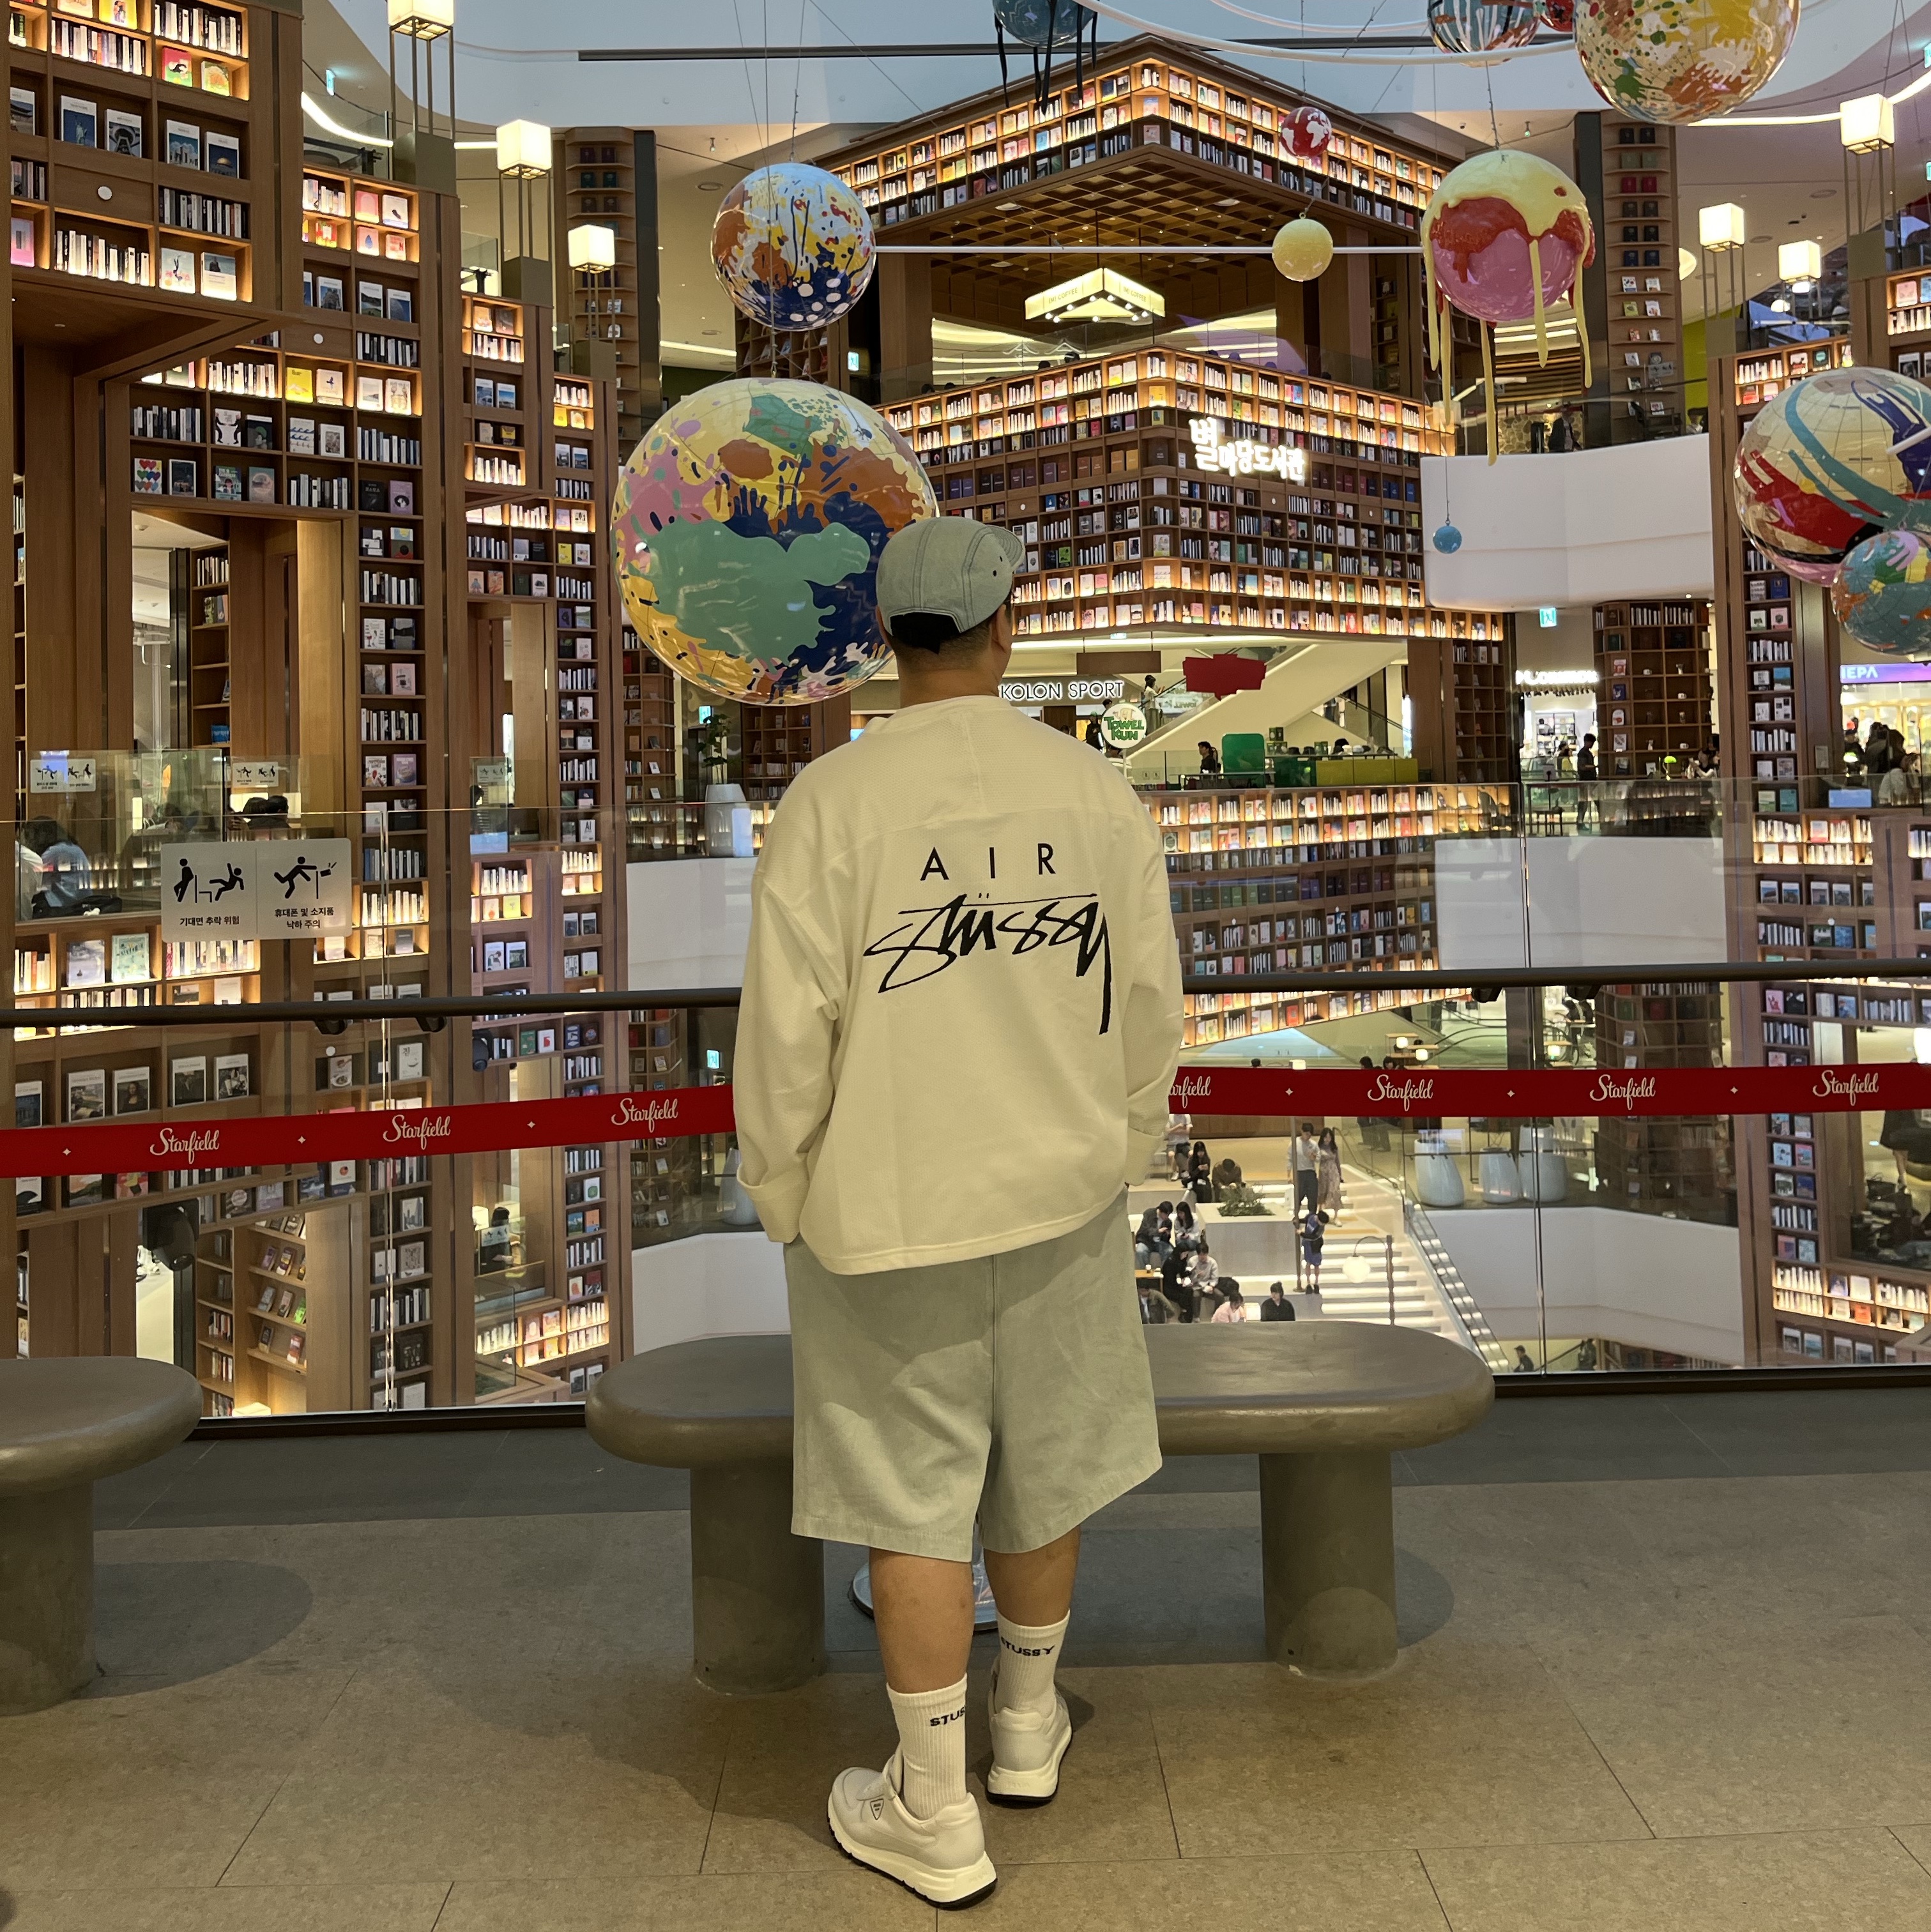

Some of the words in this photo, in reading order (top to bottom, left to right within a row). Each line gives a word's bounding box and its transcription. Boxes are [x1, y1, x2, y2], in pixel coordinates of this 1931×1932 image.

[999, 683, 1061, 701] KOLON
[1069, 681, 1124, 699] SPORT
[1104, 716, 1145, 730] TOWEL
[1111, 729, 1138, 741] KUN
[920, 843, 1056, 881] AIR
[179, 917, 204, 926] 기대면
[206, 917, 222, 925] 추락
[224, 916, 240, 925] 위험
[275, 908, 298, 917] 휴대폰
[300, 908, 309, 917] 및
[310, 907, 334, 916] 소지품
[287, 920, 303, 929] 낙하
[305, 920, 321, 929] 주의
[1169, 1076, 1212, 1109] arfield
[1368, 1074, 1433, 1112] Starfield
[1590, 1074, 1656, 1111] Starfield
[1813, 1070, 1879, 1106] Starfield
[611, 1098, 678, 1133] Starfield
[383, 1114, 451, 1150] Starfield
[150, 1128, 220, 1164] Starfield
[1001, 1636, 1055, 1656] STUSSY
[930, 1706, 965, 1726] STUS
